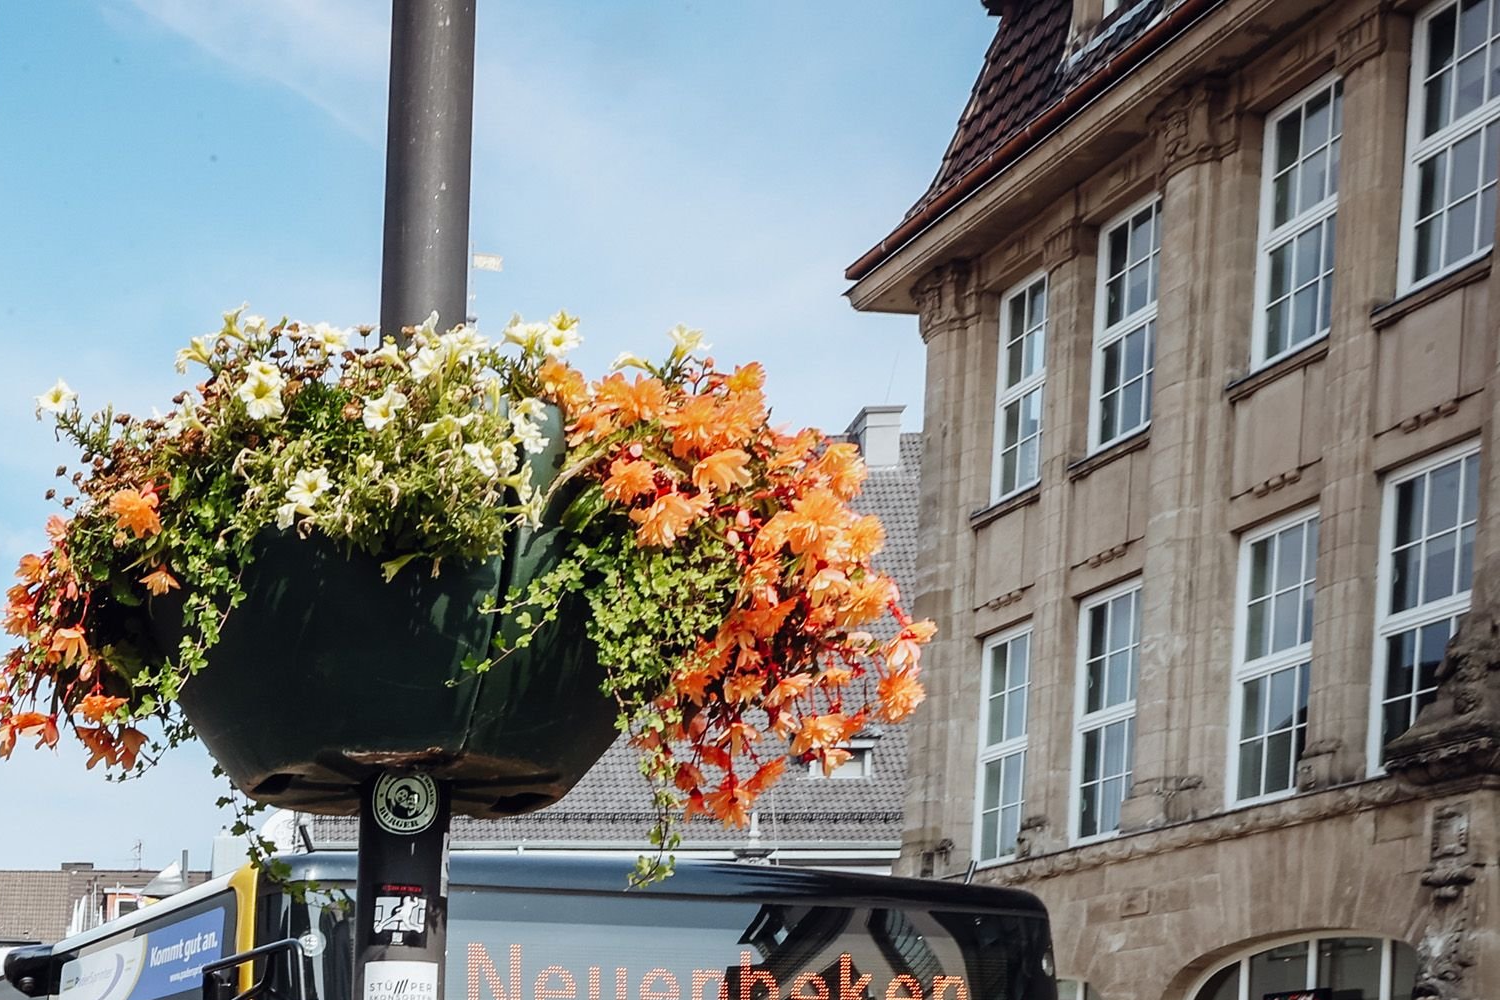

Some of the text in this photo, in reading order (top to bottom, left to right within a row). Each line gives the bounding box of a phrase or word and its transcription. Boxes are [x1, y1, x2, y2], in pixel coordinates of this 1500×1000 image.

[150, 931, 219, 968] Kommt gut an.
